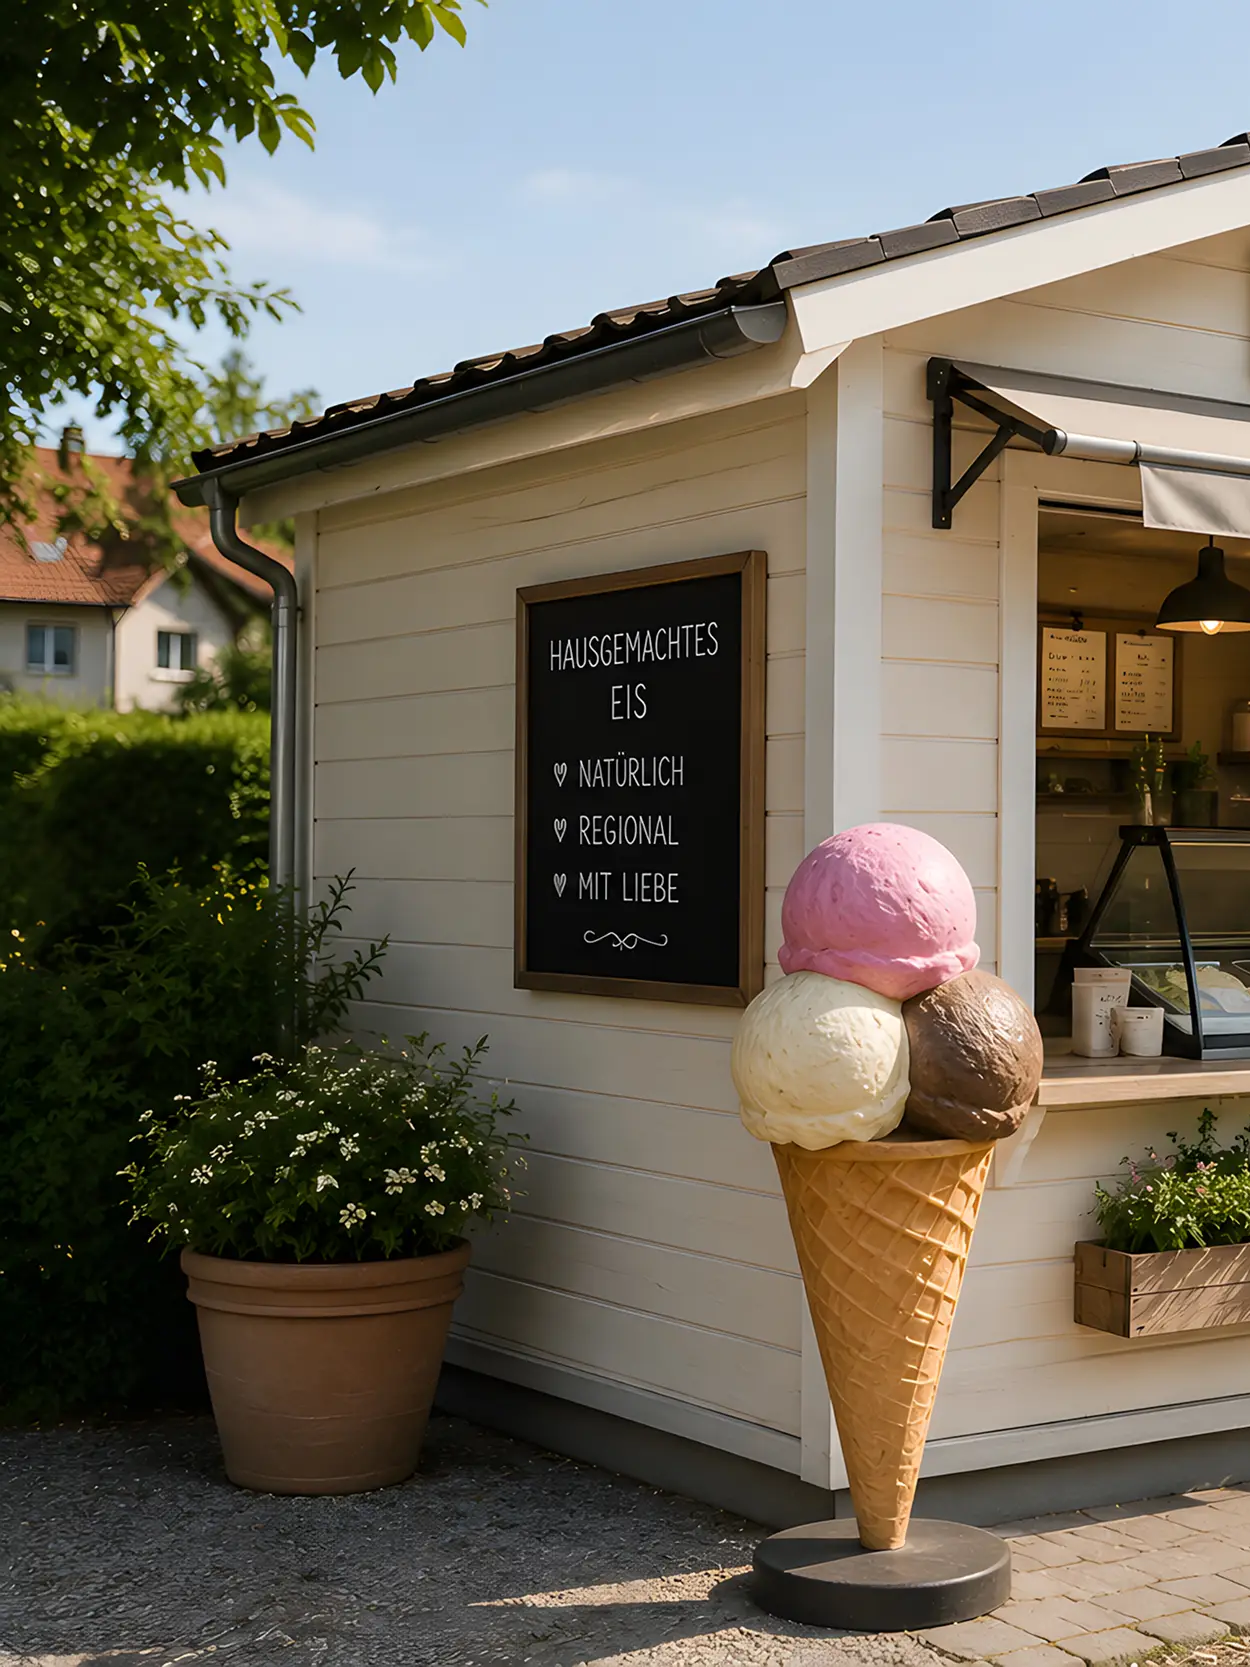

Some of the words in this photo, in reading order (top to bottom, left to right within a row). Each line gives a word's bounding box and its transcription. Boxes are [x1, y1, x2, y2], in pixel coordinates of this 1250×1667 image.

[550, 621, 719, 671] HAUSGEMACHTES
[611, 682, 647, 720] EIS
[579, 751, 684, 788] NATÜRLICH
[579, 814, 679, 846] REGIONAL
[579, 871, 612, 901] MIT
[622, 872, 679, 904] LIEBE
